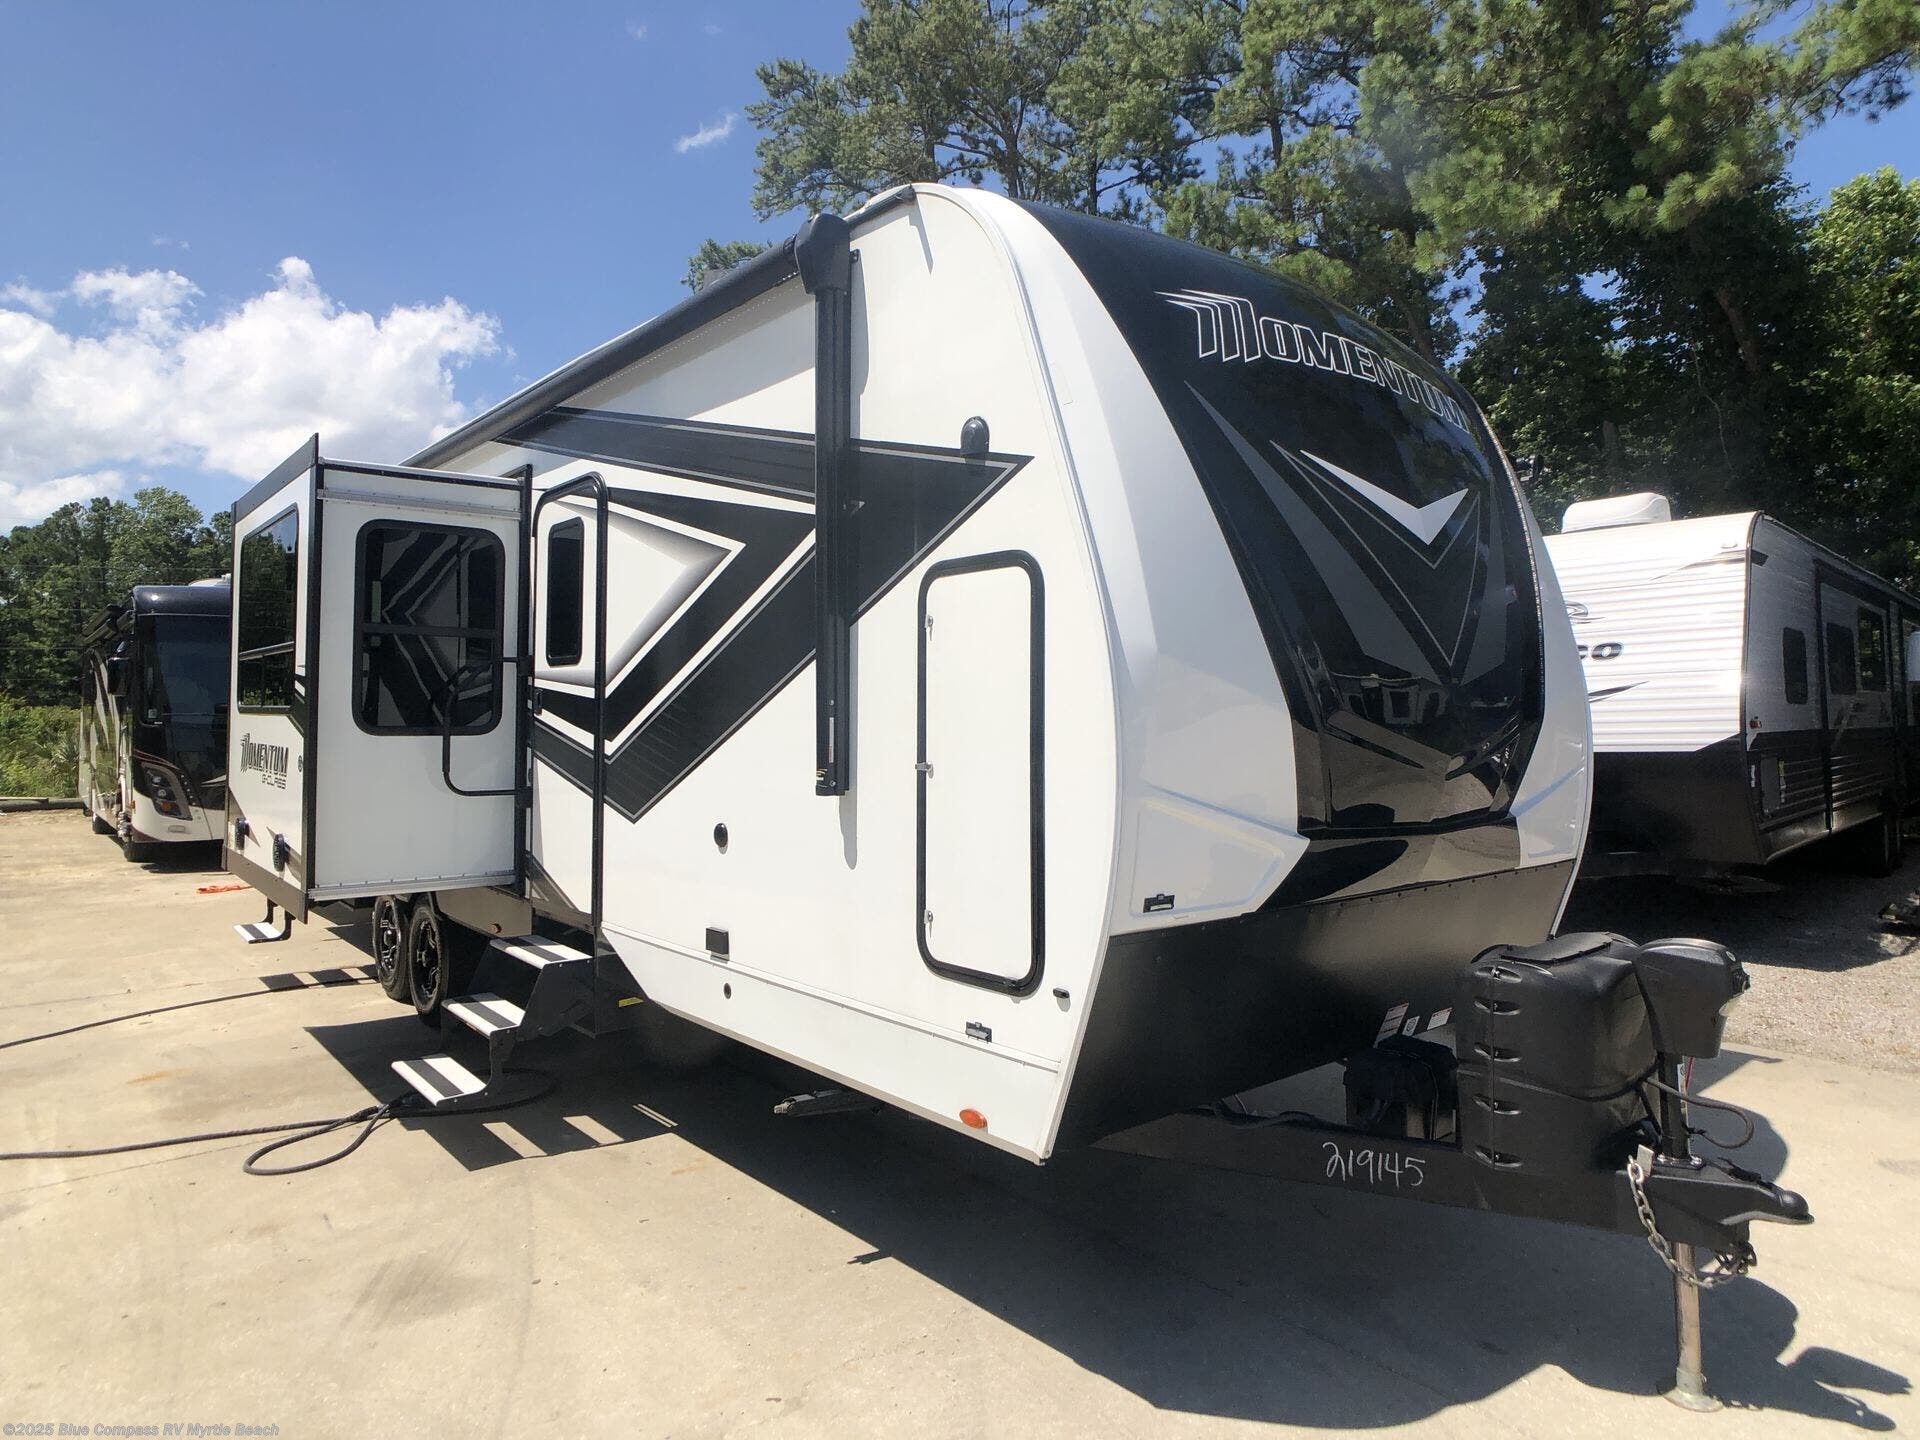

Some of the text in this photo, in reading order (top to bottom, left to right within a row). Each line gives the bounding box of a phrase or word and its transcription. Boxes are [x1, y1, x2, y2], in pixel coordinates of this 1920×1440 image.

[1153, 288, 1470, 434] MOMENTUM
[240, 732, 289, 778] MOMENTUM
[1322, 1141, 1426, 1190] 219145
